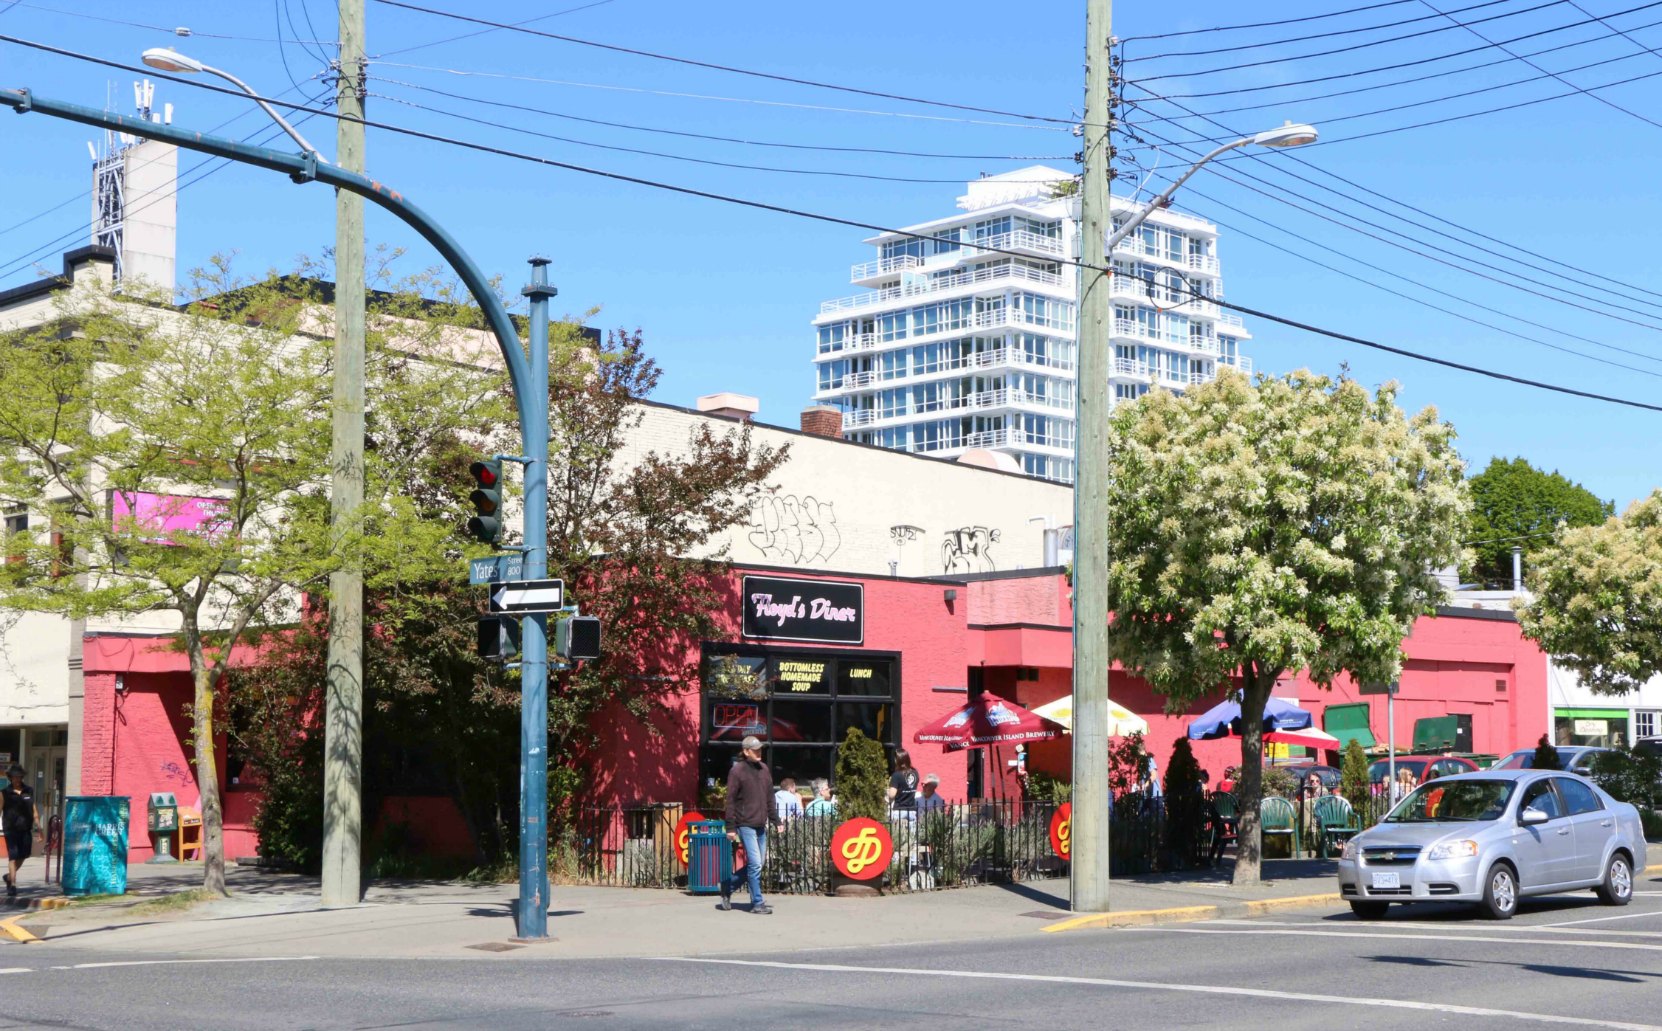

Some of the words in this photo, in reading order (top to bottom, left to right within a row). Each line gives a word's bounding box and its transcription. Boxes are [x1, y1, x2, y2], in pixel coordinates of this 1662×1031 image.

[474, 562, 498, 579] Yates
[507, 566, 520, 576] 800
[751, 593, 805, 627] Floyd's
[810, 597, 856, 622] Diner
[779, 662, 824, 673] BOTTOMLESS
[781, 672, 821, 682] HOMEMADE
[850, 668, 872, 678] LUNCH
[791, 682, 811, 692] SOUP
[1003, 733, 1025, 741] ISLAND
[1025, 730, 1055, 739] BREWERY
[95, 822, 125, 830] HARRIS
